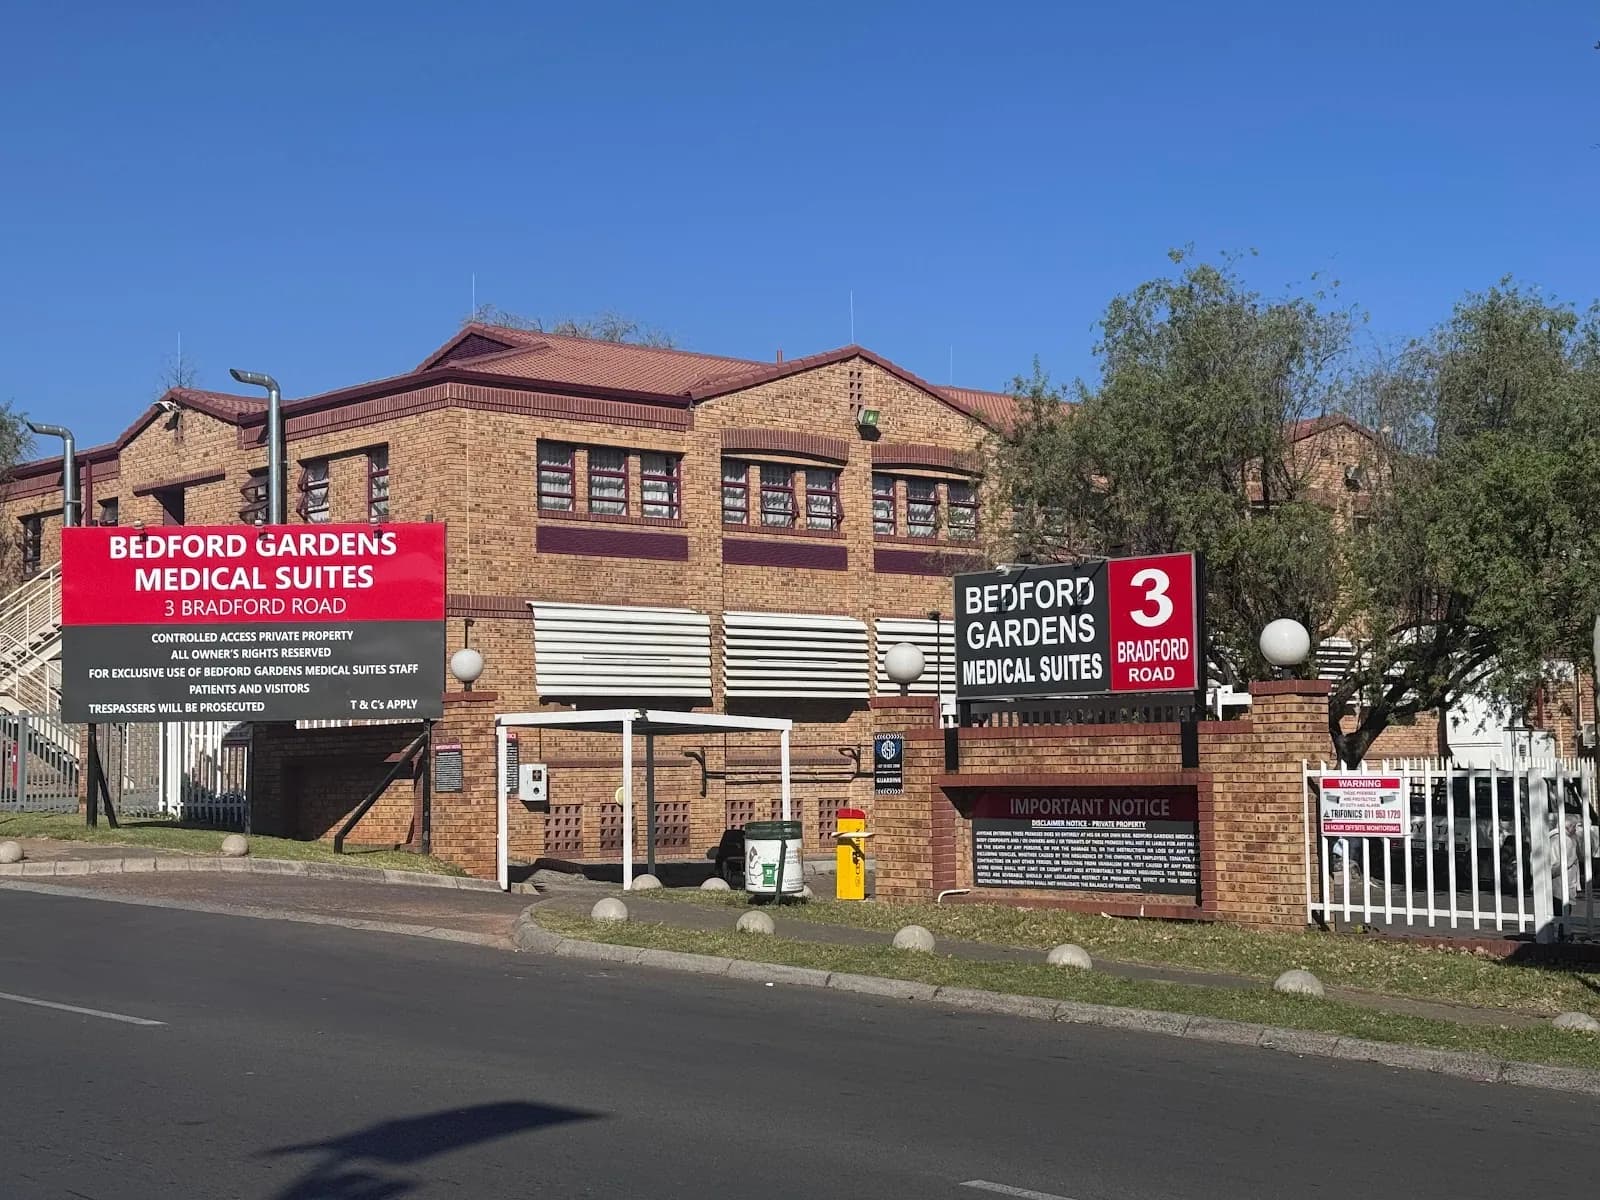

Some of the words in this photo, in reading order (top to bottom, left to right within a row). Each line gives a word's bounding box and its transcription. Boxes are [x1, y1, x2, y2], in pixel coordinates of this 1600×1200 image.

[110, 535, 247, 559] BEDFORD
[256, 532, 396, 557] GARDENS
[136, 567, 266, 591] MEDICAL
[276, 565, 373, 589] SUITES
[966, 577, 1094, 614] BEDFORD
[1131, 569, 1173, 627] 3
[165, 600, 174, 616] 3
[182, 599, 285, 616] BRADFORD
[292, 598, 346, 614] ROAD
[152, 633, 217, 643] CONTROLLED
[220, 632, 256, 642] ACCESS
[259, 632, 299, 641] PRIVATE
[302, 631, 353, 640] PROPERTY
[967, 614, 1095, 649] GARDENS
[171, 650, 189, 659] ALL
[242, 648, 278, 658] RIGHTS
[282, 648, 331, 658] RESERVED
[1118, 638, 1188, 663] BRADFORD
[89, 669, 109, 678] FOR
[112, 668, 164, 678] EXCLUSIVE
[167, 668, 185, 677] USE
[188, 668, 201, 677] OF
[204, 667, 251, 676] BEDFORD
[254, 666, 302, 676] GARDENS
[305, 666, 350, 675] MEDICAL
[353, 665, 386, 674] SUITES
[389, 664, 418, 674] STAFF
[963, 657, 1035, 685] MEDICAL
[1040, 653, 1102, 682] SUITES
[1129, 667, 1174, 682] ROAD
[190, 684, 236, 694] PATIENTS
[239, 684, 262, 694] AND
[264, 684, 310, 693] VISITORS
[89, 704, 155, 714] TRESPASSERS
[158, 704, 183, 713] WILL
[185, 703, 197, 712] BE
[200, 702, 265, 712] PROSECUTED
[350, 700, 357, 709] T
[360, 700, 368, 709] &
[387, 700, 417, 709] APPLY
[882, 740, 895, 760] BSG
[1011, 798, 1104, 816] IMPORTANT
[1110, 799, 1170, 816] NOTICE
[1331, 810, 1362, 818] TRIFONICS
